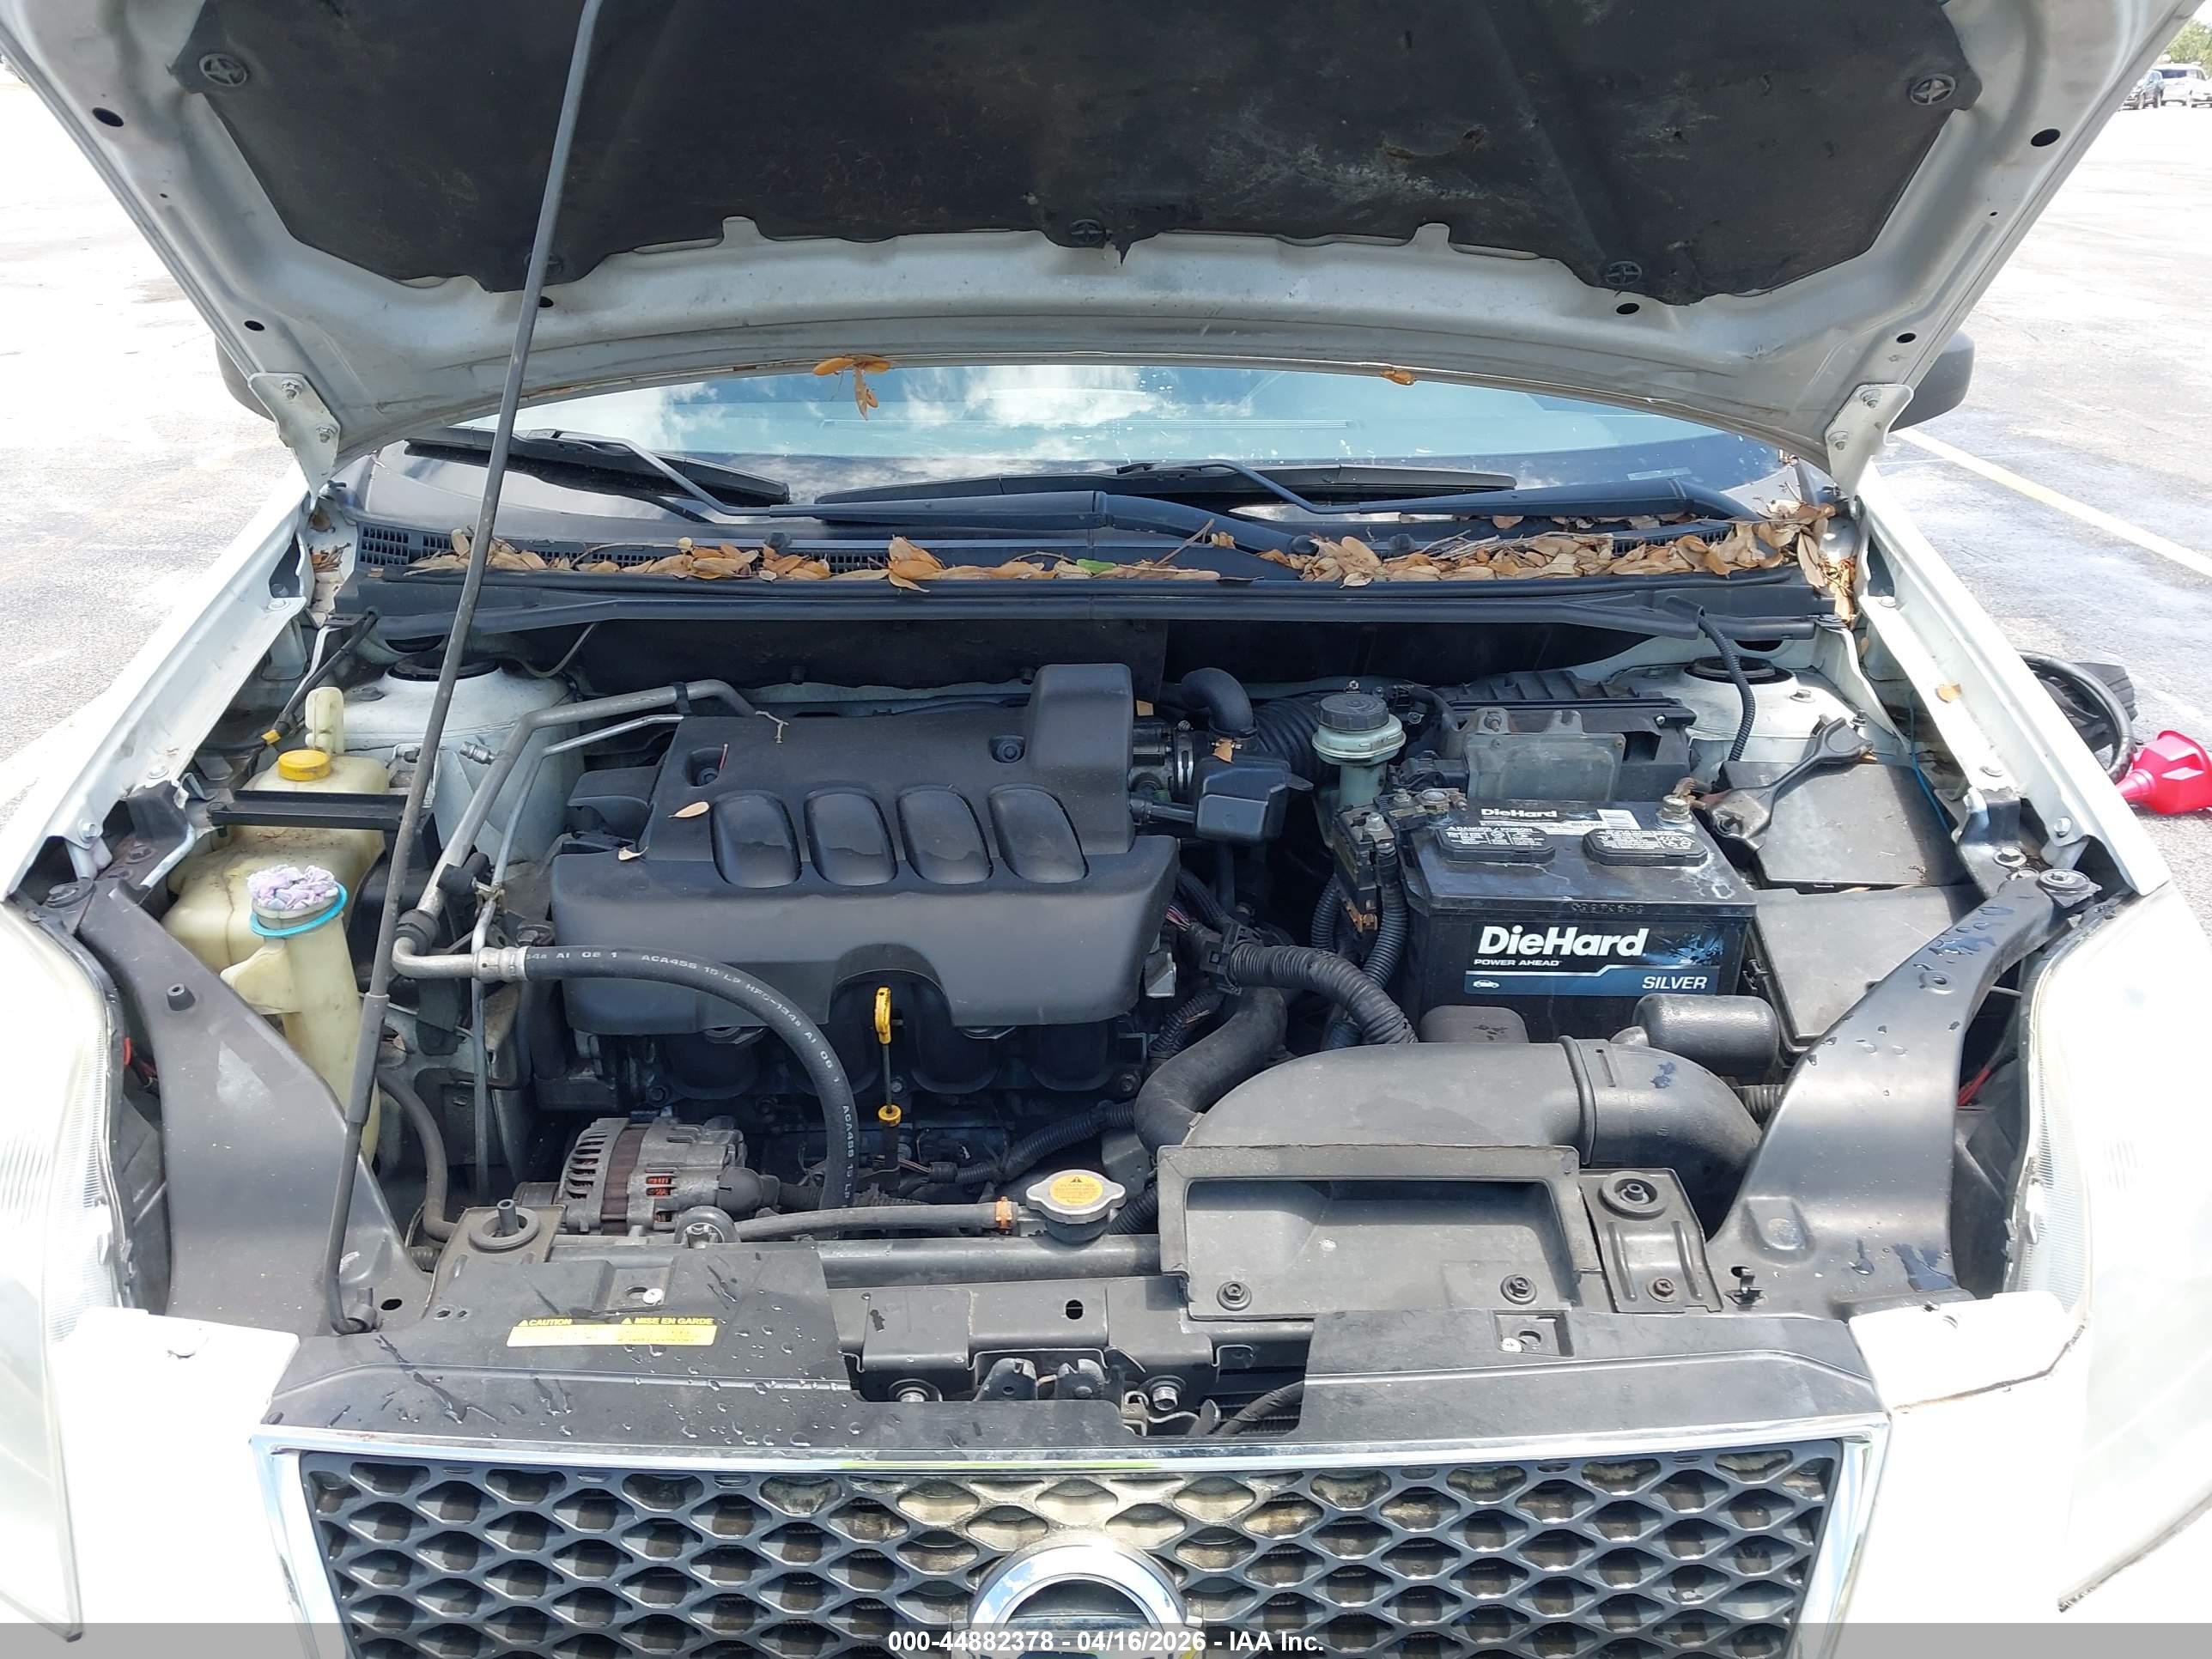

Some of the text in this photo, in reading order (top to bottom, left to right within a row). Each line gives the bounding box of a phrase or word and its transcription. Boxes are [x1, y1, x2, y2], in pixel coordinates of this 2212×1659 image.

[1481, 808, 1558, 817] DieHard
[1477, 925, 1650, 957] DieHard
[1641, 976, 1708, 989] SILVER
[634, 1316, 660, 1325] MISE
